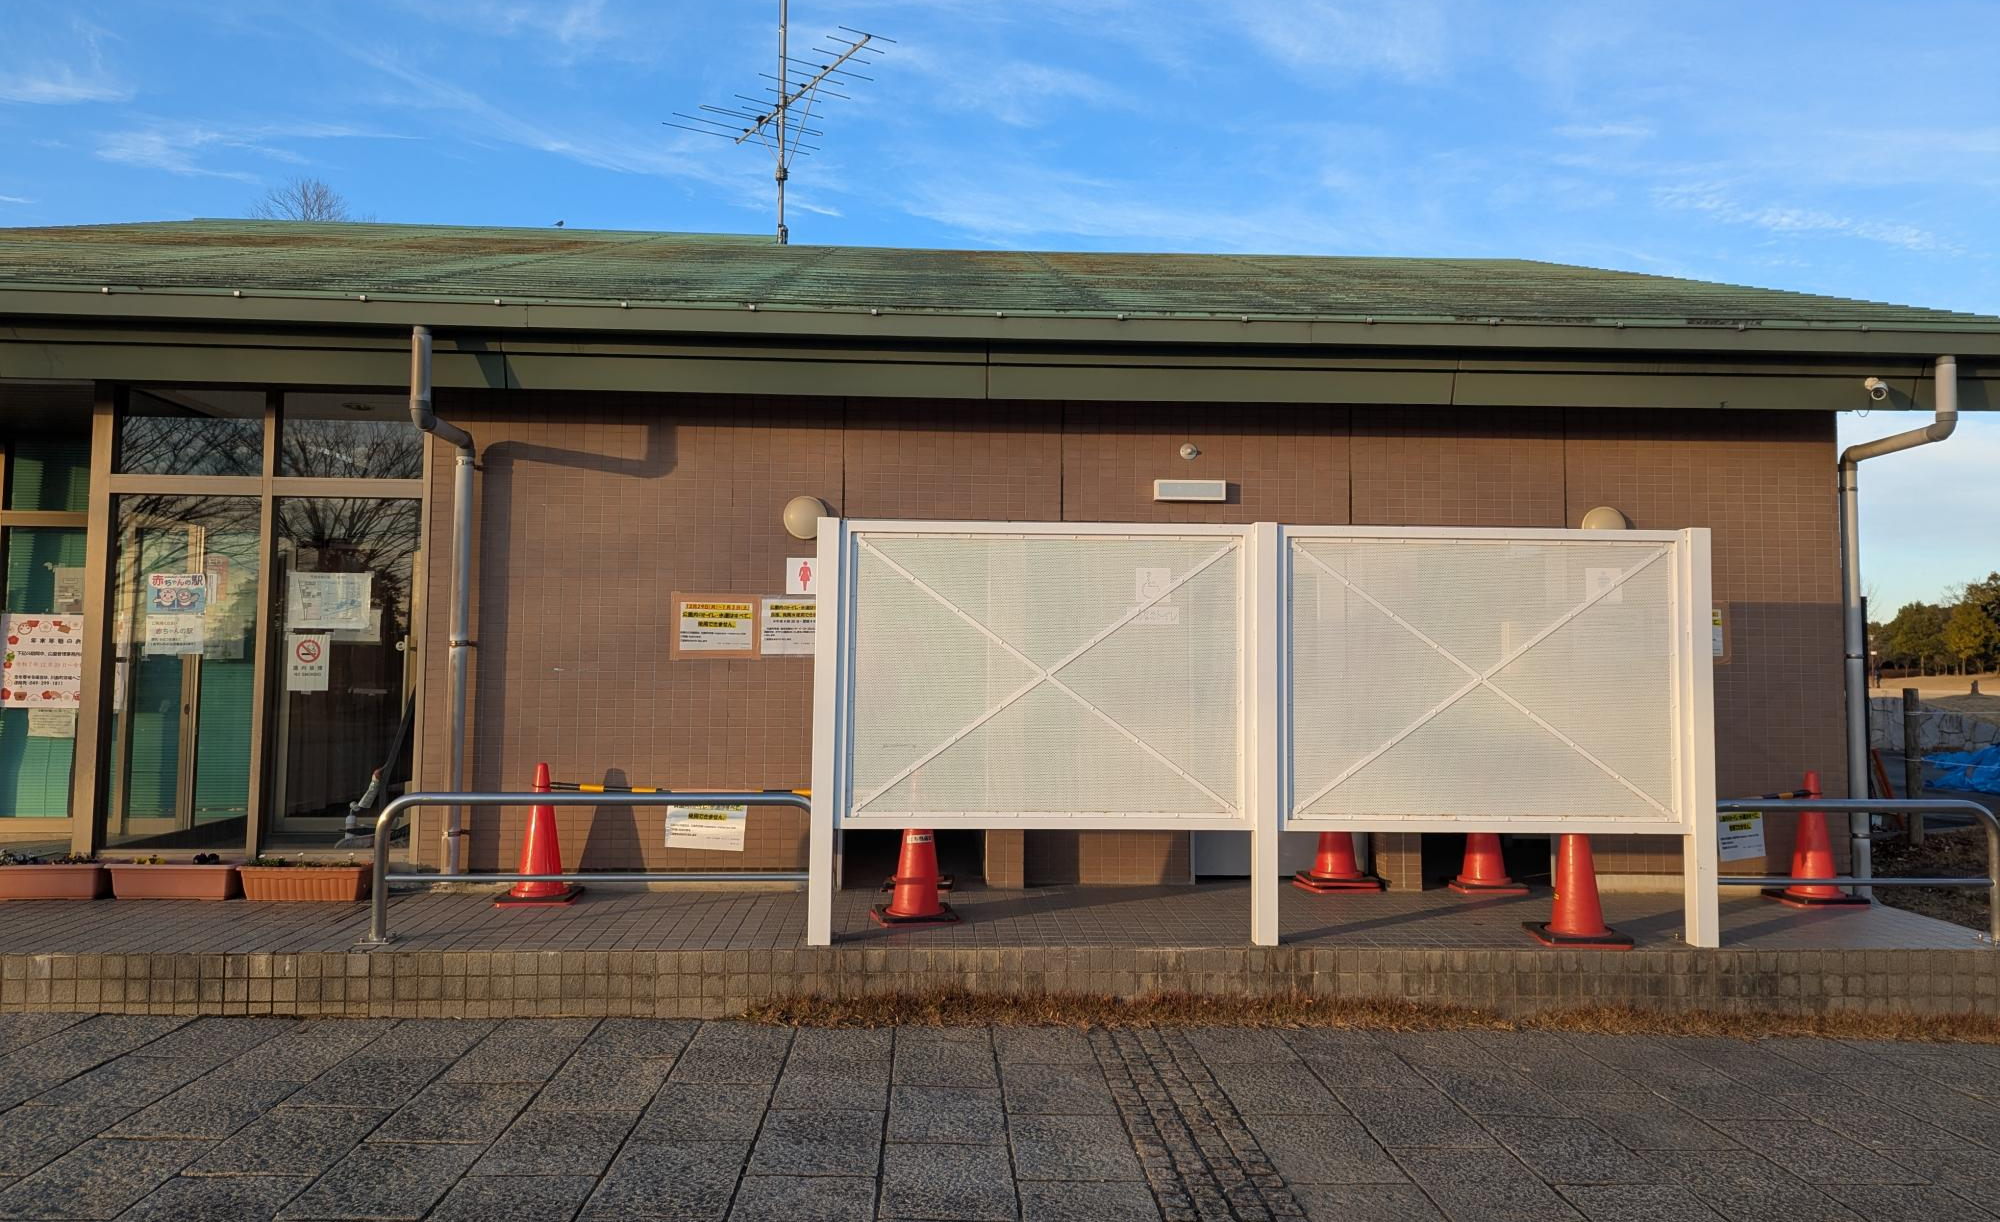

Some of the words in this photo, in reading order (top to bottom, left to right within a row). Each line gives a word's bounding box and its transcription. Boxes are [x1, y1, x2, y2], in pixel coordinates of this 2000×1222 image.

[152, 575, 203, 586] 赤ちゃんの駅
